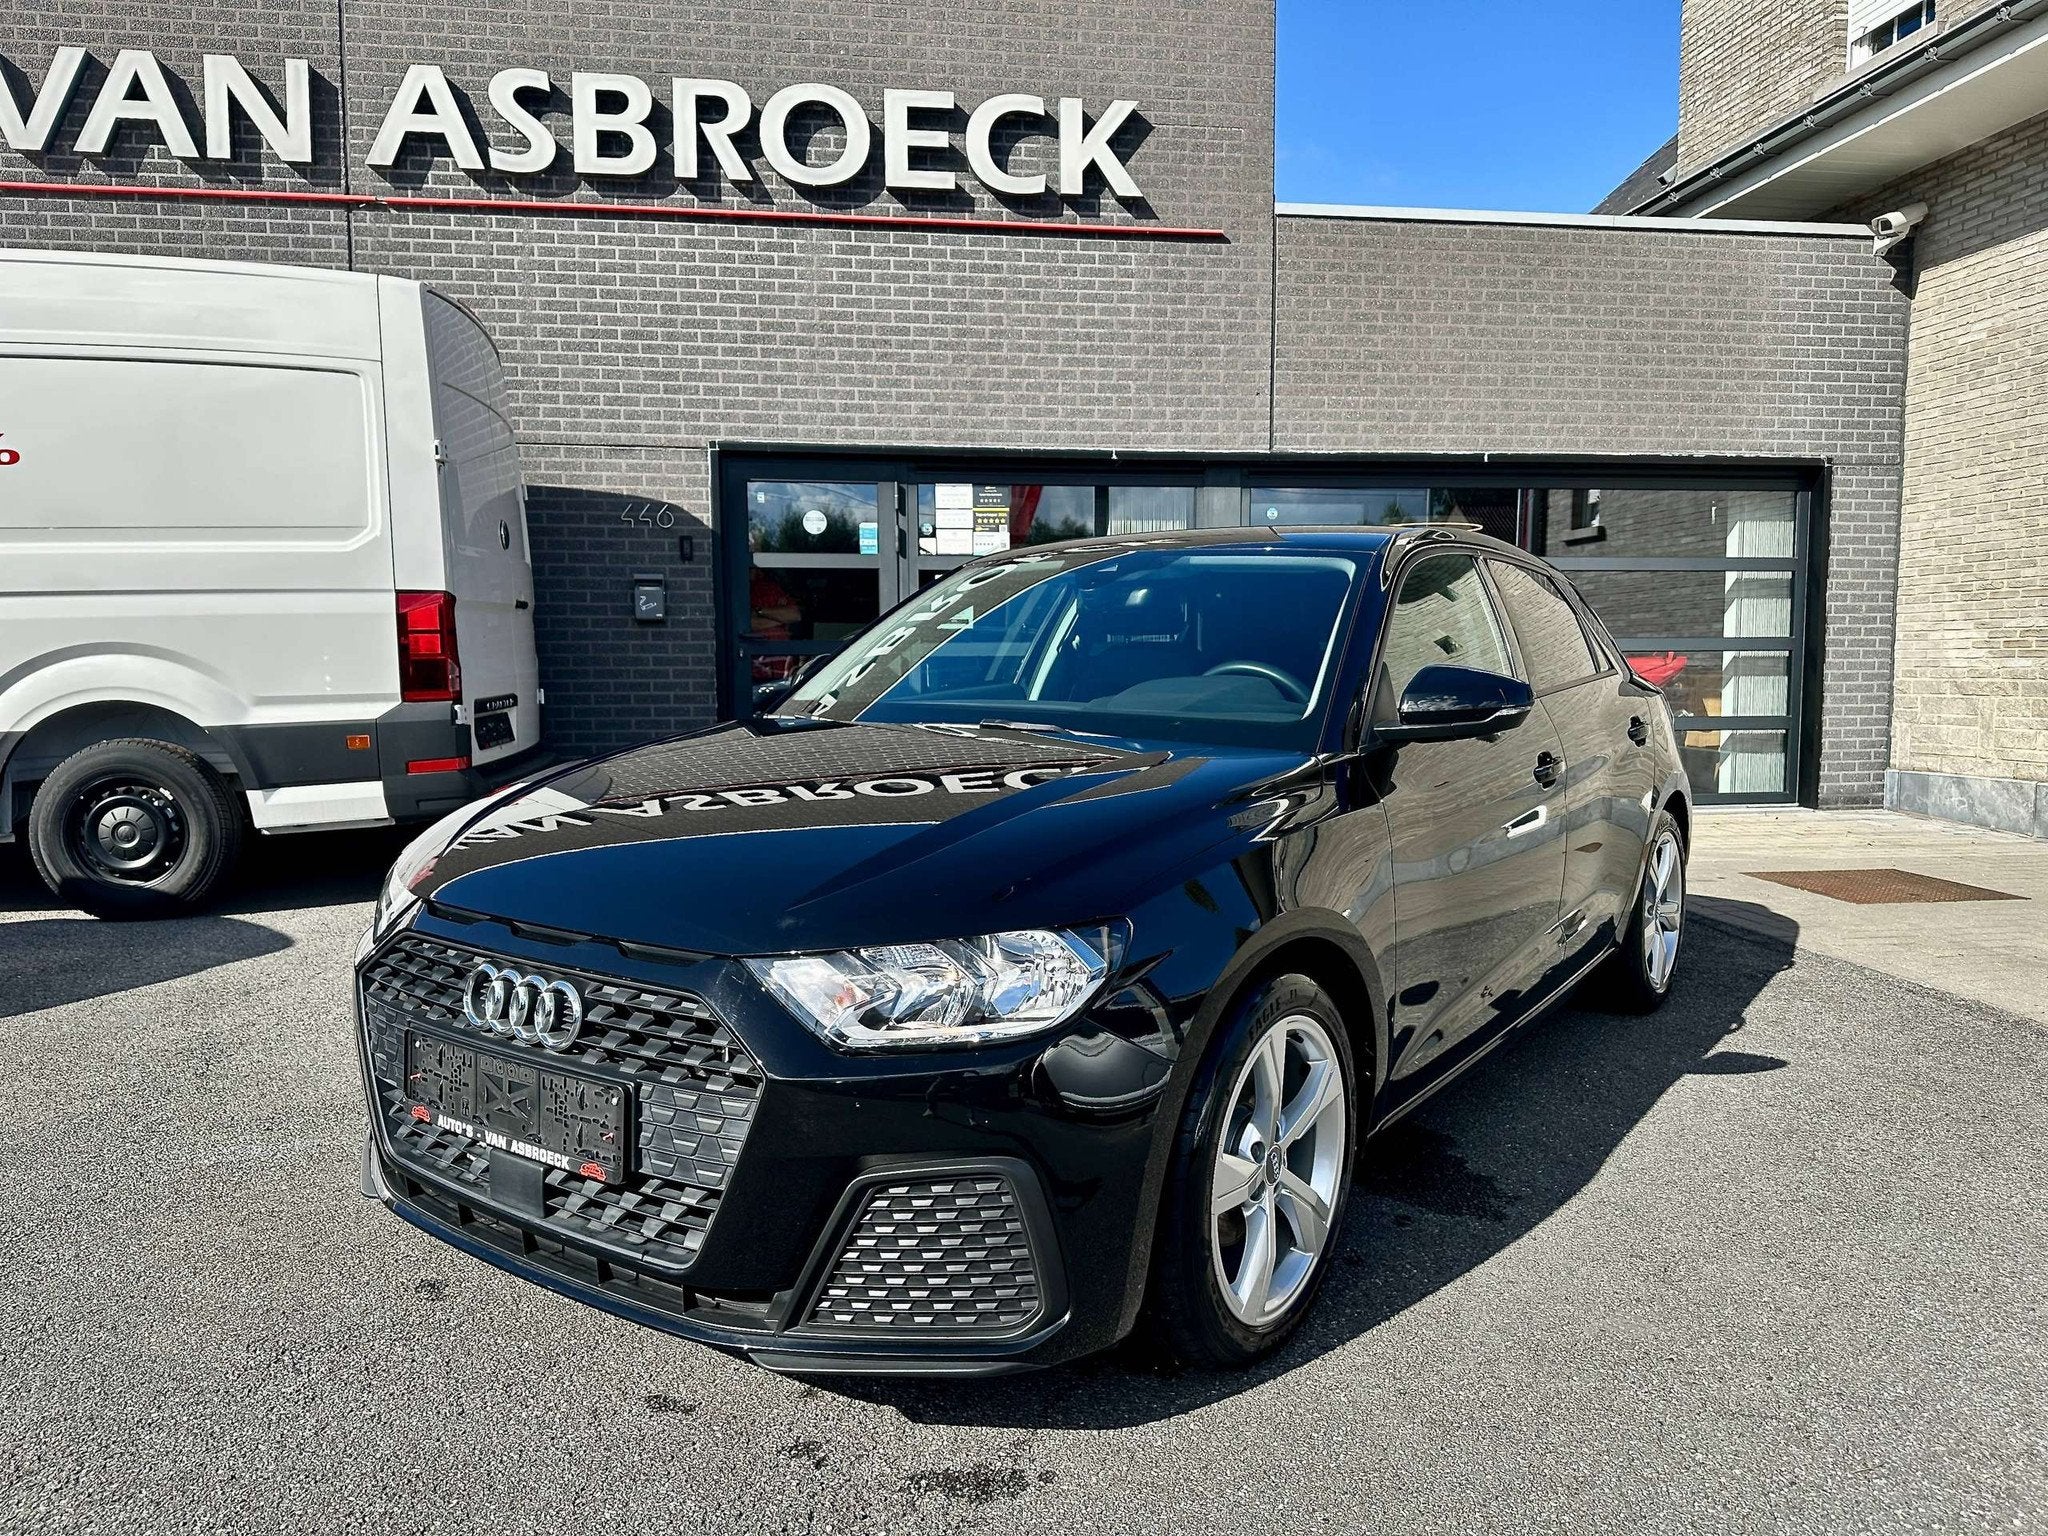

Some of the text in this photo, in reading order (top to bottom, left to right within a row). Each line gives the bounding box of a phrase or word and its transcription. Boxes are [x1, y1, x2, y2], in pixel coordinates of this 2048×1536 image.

[0, 45, 1142, 198] VAN ASBROECK
[620, 502, 675, 529] 446
[437, 1114, 474, 1139] AUTO'S
[484, 1130, 507, 1150] VAN
[510, 1141, 571, 1171] ASBROECK
